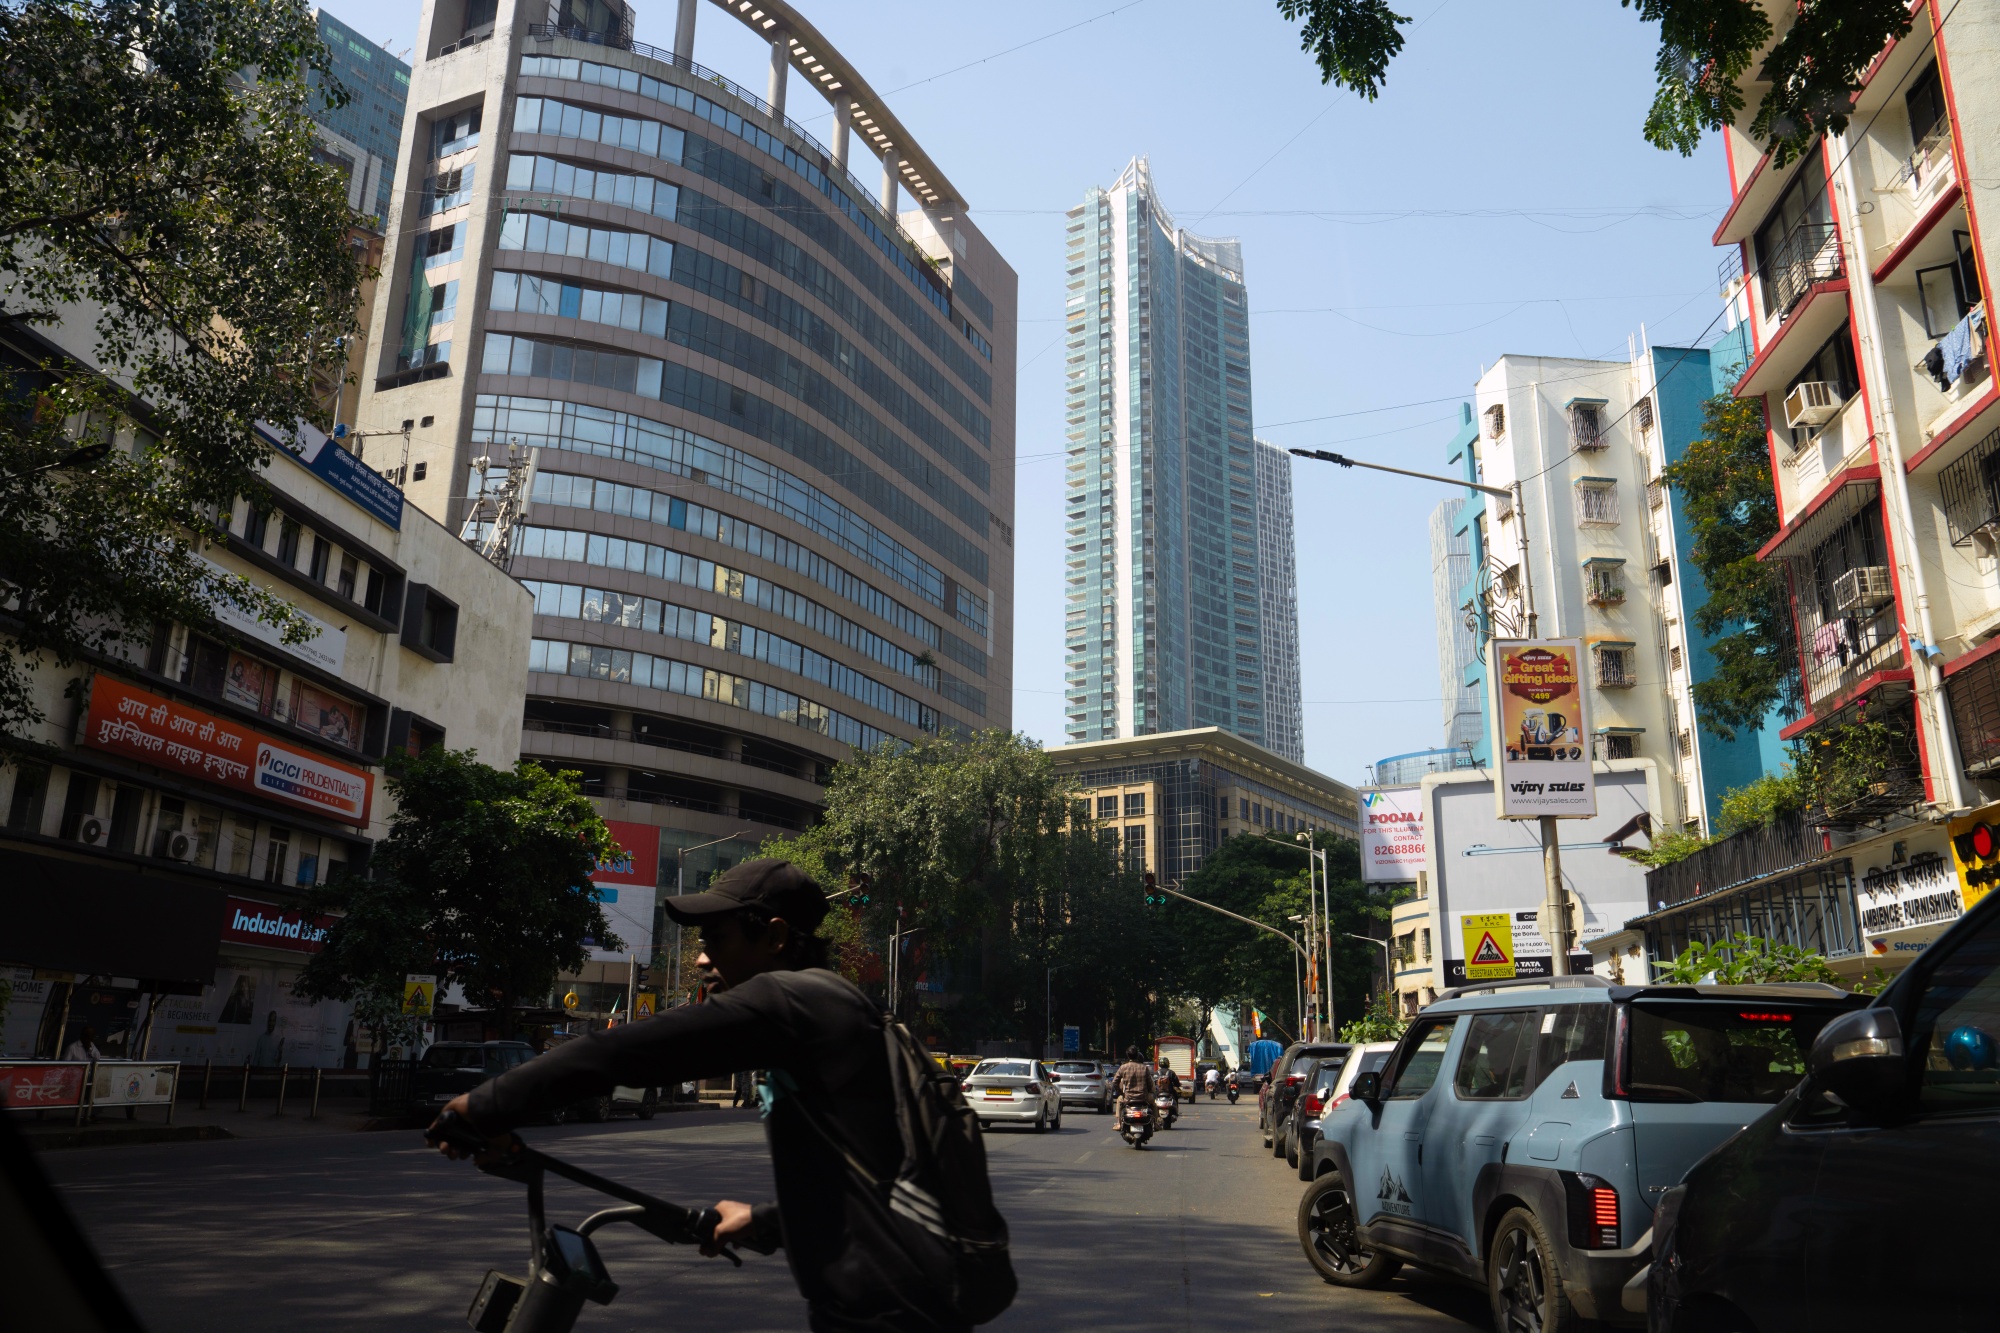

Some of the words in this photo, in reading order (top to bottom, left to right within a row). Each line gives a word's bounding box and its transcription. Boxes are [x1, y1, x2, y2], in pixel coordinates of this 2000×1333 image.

[369, 488, 378, 498] LIFE
[225, 606, 237, 617] Skin
[241, 613, 255, 626] Laser
[255, 621, 270, 633] Clinic
[1520, 662, 1554, 673] Great
[1502, 673, 1543, 686] Gifting
[1544, 673, 1577, 684] Ideas
[118, 696, 147, 719] आय
[150, 704, 169, 727] सी
[170, 714, 197, 735] आय
[199, 721, 216, 742] सी
[216, 729, 242, 752] आय
[166, 741, 204, 766] लाइफ
[204, 753, 249, 781] इन्शुरन्स
[269, 757, 301, 780] ICICI
[301, 769, 351, 797] PRUDENTIAL
[265, 776, 286, 789] LIFE
[291, 784, 341, 806] INSURANCE
[1510, 781, 1545, 795] vijay
[1548, 781, 1585, 792] sales
[1511, 796, 1588, 805] www.vijaysales.com
[1368, 812, 1415, 824] POOJA
[1862, 903, 1900, 929] AMBIENCE
[1902, 889, 1958, 921] FURNISHING
[231, 908, 303, 939] IndusInd
[1470, 968, 1493, 978] PEDESTRIAN
[1493, 967, 1514, 977] CROSSING
[12, 980, 44, 994] HOME
[14, 1077, 65, 1101] बेस्ट
[1381, 1200, 1411, 1216] ADVENTURE
